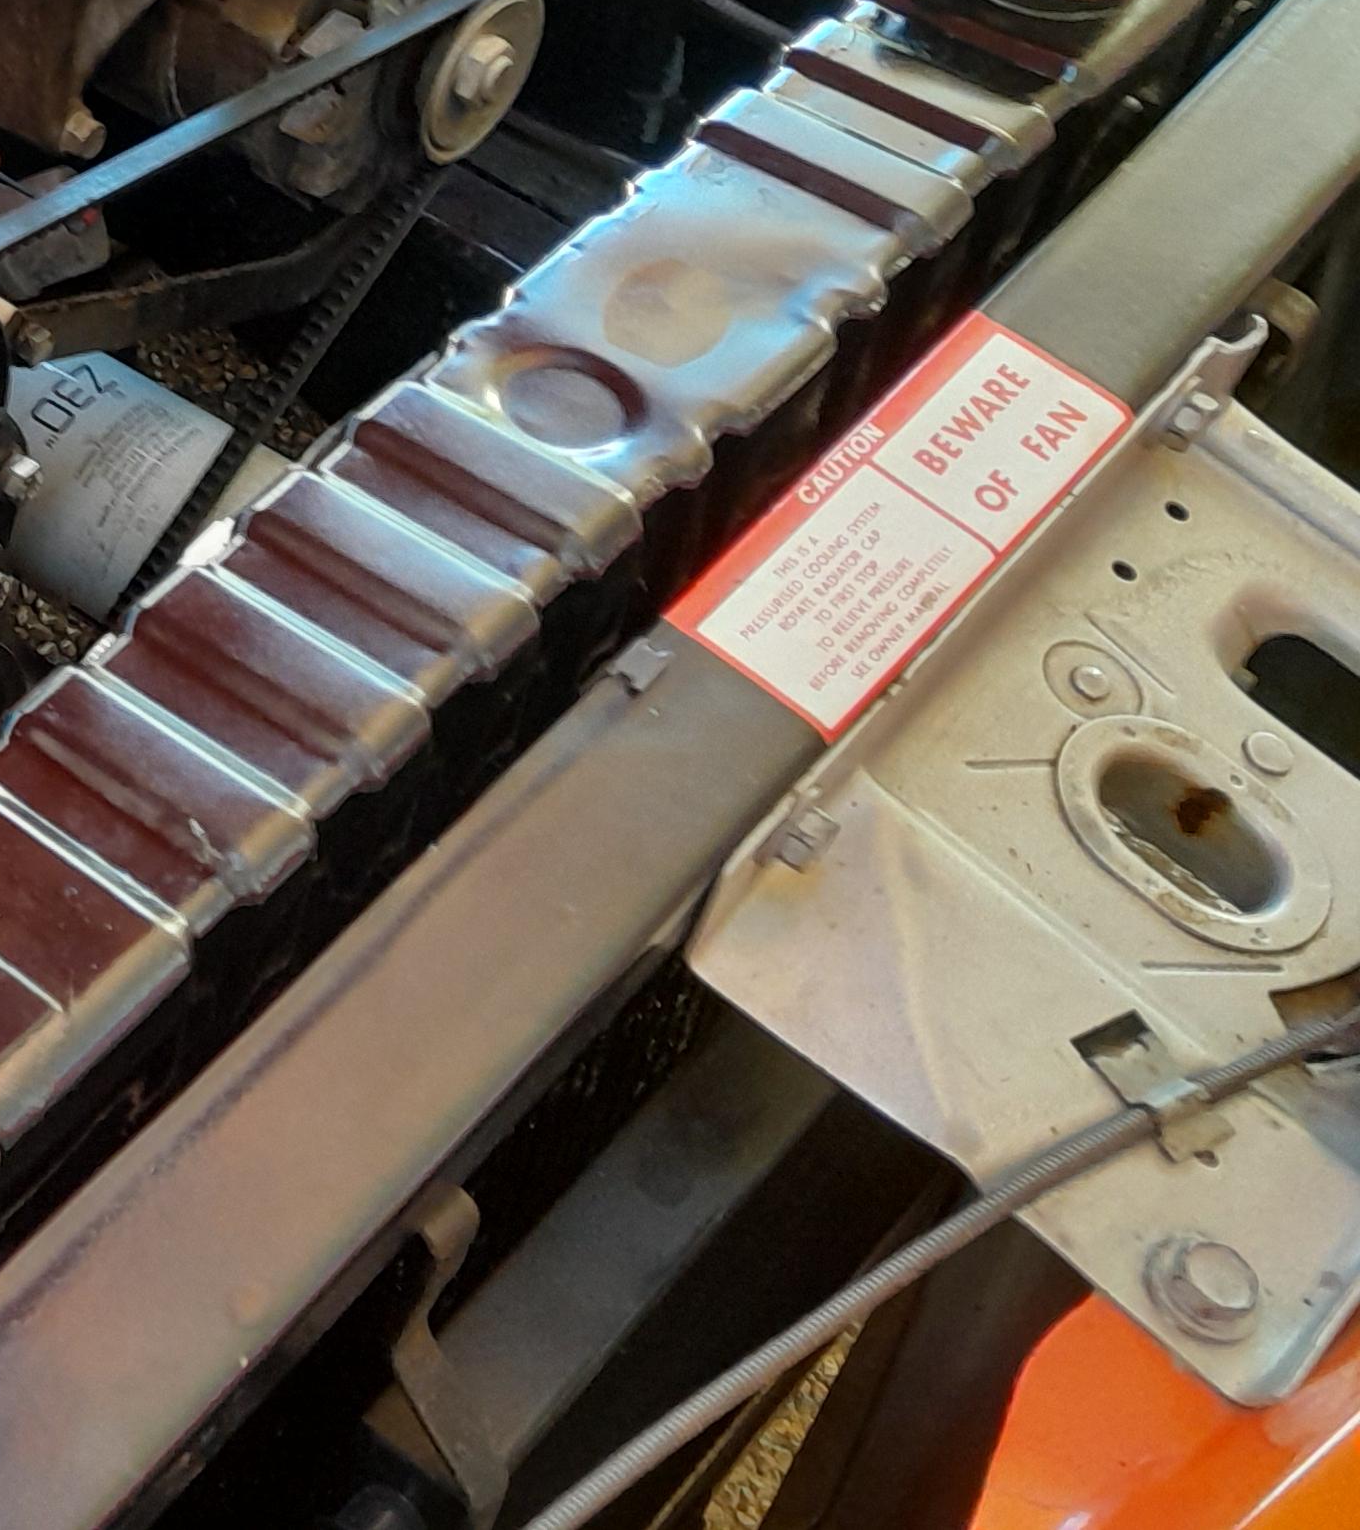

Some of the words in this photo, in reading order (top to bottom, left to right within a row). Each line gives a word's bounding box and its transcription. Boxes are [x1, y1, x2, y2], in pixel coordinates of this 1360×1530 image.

[797, 422, 886, 506] CAUTION
[912, 363, 1031, 476] BEWARE
[974, 469, 1019, 513] OF
[1020, 400, 1089, 462] FAN
[739, 579, 804, 641] PRESSURISED
[802, 534, 849, 579] COOLING
[846, 502, 881, 536] SYSTEM
[773, 556, 799, 579] THIS
[797, 544, 811, 557] IS
[808, 535, 819, 547] A
[778, 596, 817, 632] ROTATE
[813, 549, 863, 597] RADIATOR
[860, 529, 881, 550] CAP
[814, 608, 832, 625] TO
[830, 582, 856, 610] FIRST
[854, 559, 878, 585] STOP
[816, 635, 835, 653] TO
[832, 598, 872, 637] RELIEVE
[867, 556, 914, 601] PRESSURE
[808, 654, 848, 692] BEFORE
[843, 601, 898, 654] REMOVING
[896, 545, 955, 602] COMPLETELY
[850, 660, 873, 680] SEE
[867, 622, 906, 663] OWNER
